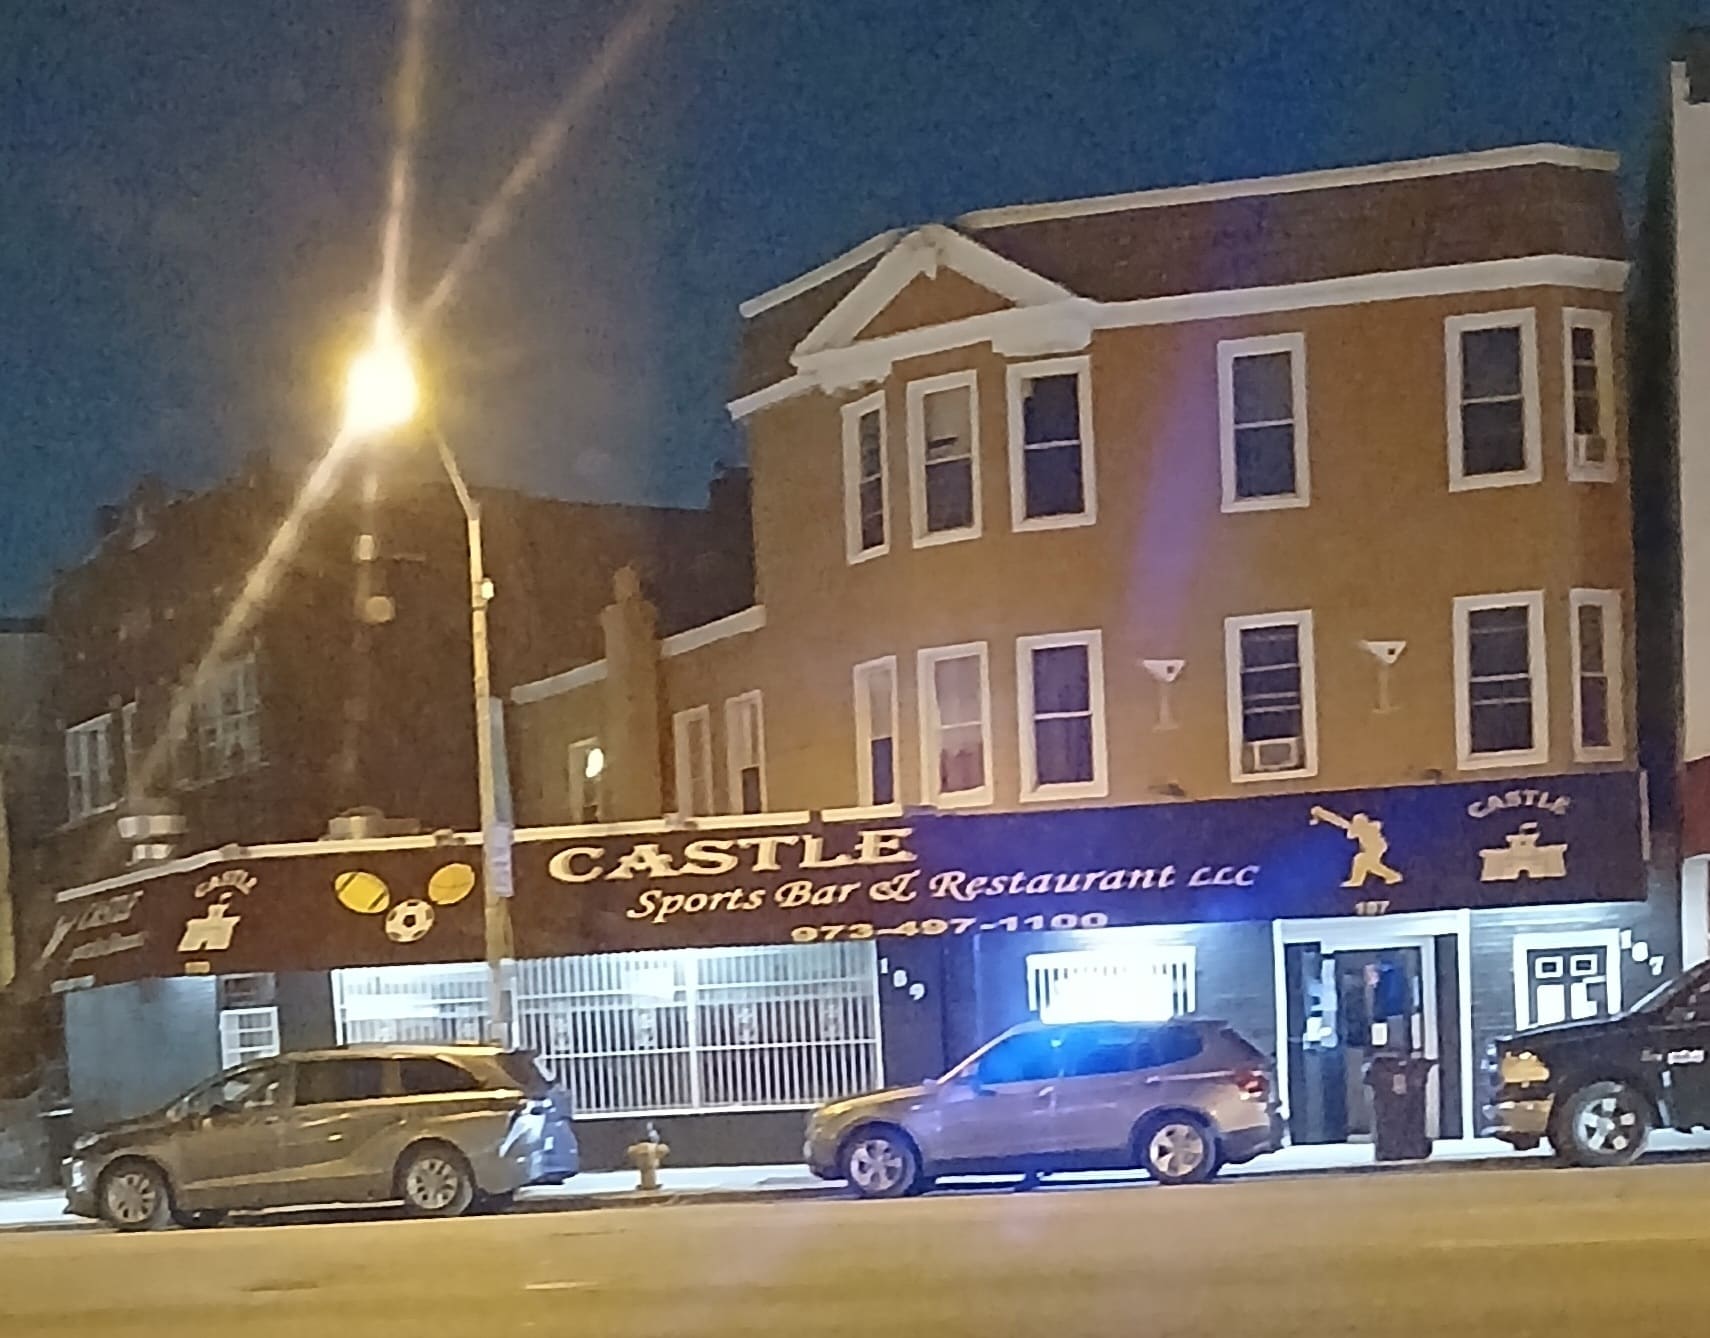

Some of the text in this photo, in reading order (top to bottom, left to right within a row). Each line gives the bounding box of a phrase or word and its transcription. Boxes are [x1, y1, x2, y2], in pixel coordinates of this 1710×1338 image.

[1467, 789, 1571, 818] CASTLE
[548, 827, 918, 883] CASTLE
[626, 864, 1261, 923] Sports Bar & Restaurant LLC
[790, 912, 1109, 943] 973-497-1100
